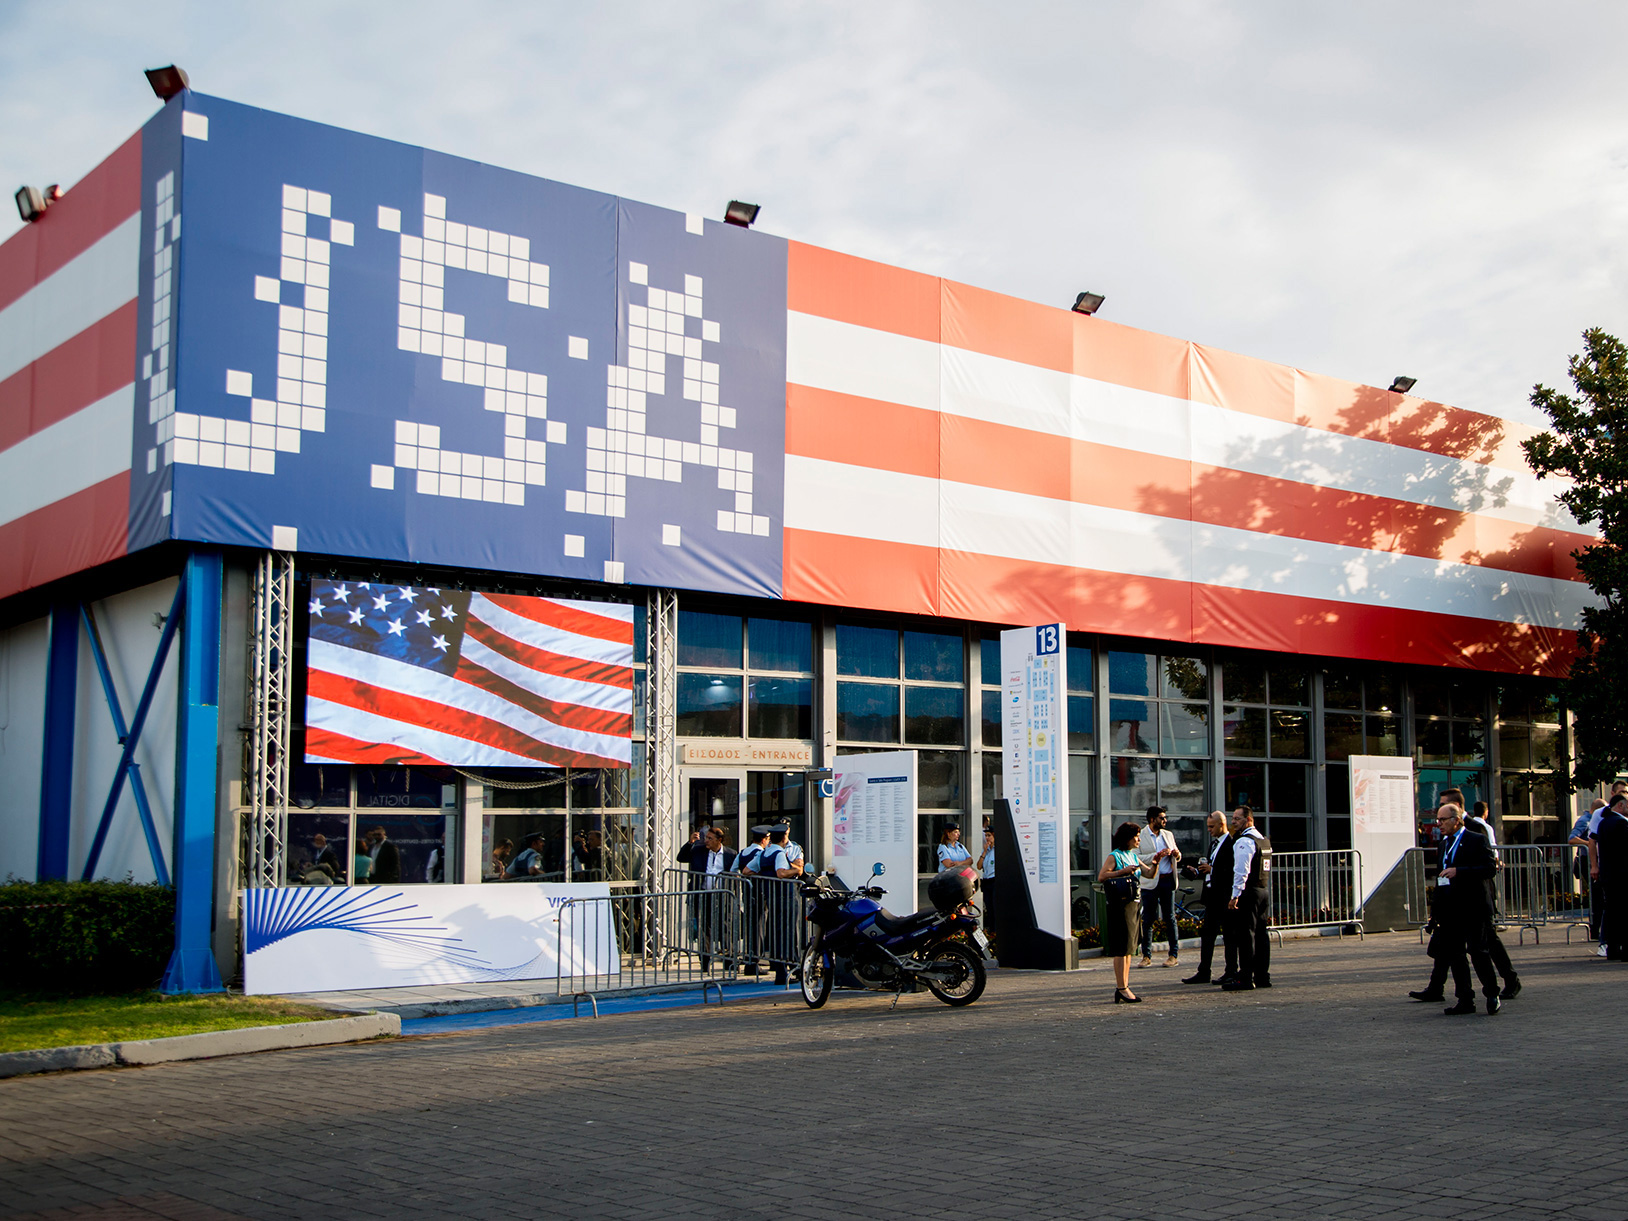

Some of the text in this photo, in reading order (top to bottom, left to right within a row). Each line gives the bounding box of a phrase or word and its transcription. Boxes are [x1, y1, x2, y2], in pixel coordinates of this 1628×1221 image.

[1038, 626, 1058, 654] 13
[689, 749, 741, 759] ΕΙΣΟΔΟΣ
[752, 750, 810, 760] ENTRANCE
[546, 896, 576, 908] VISA
